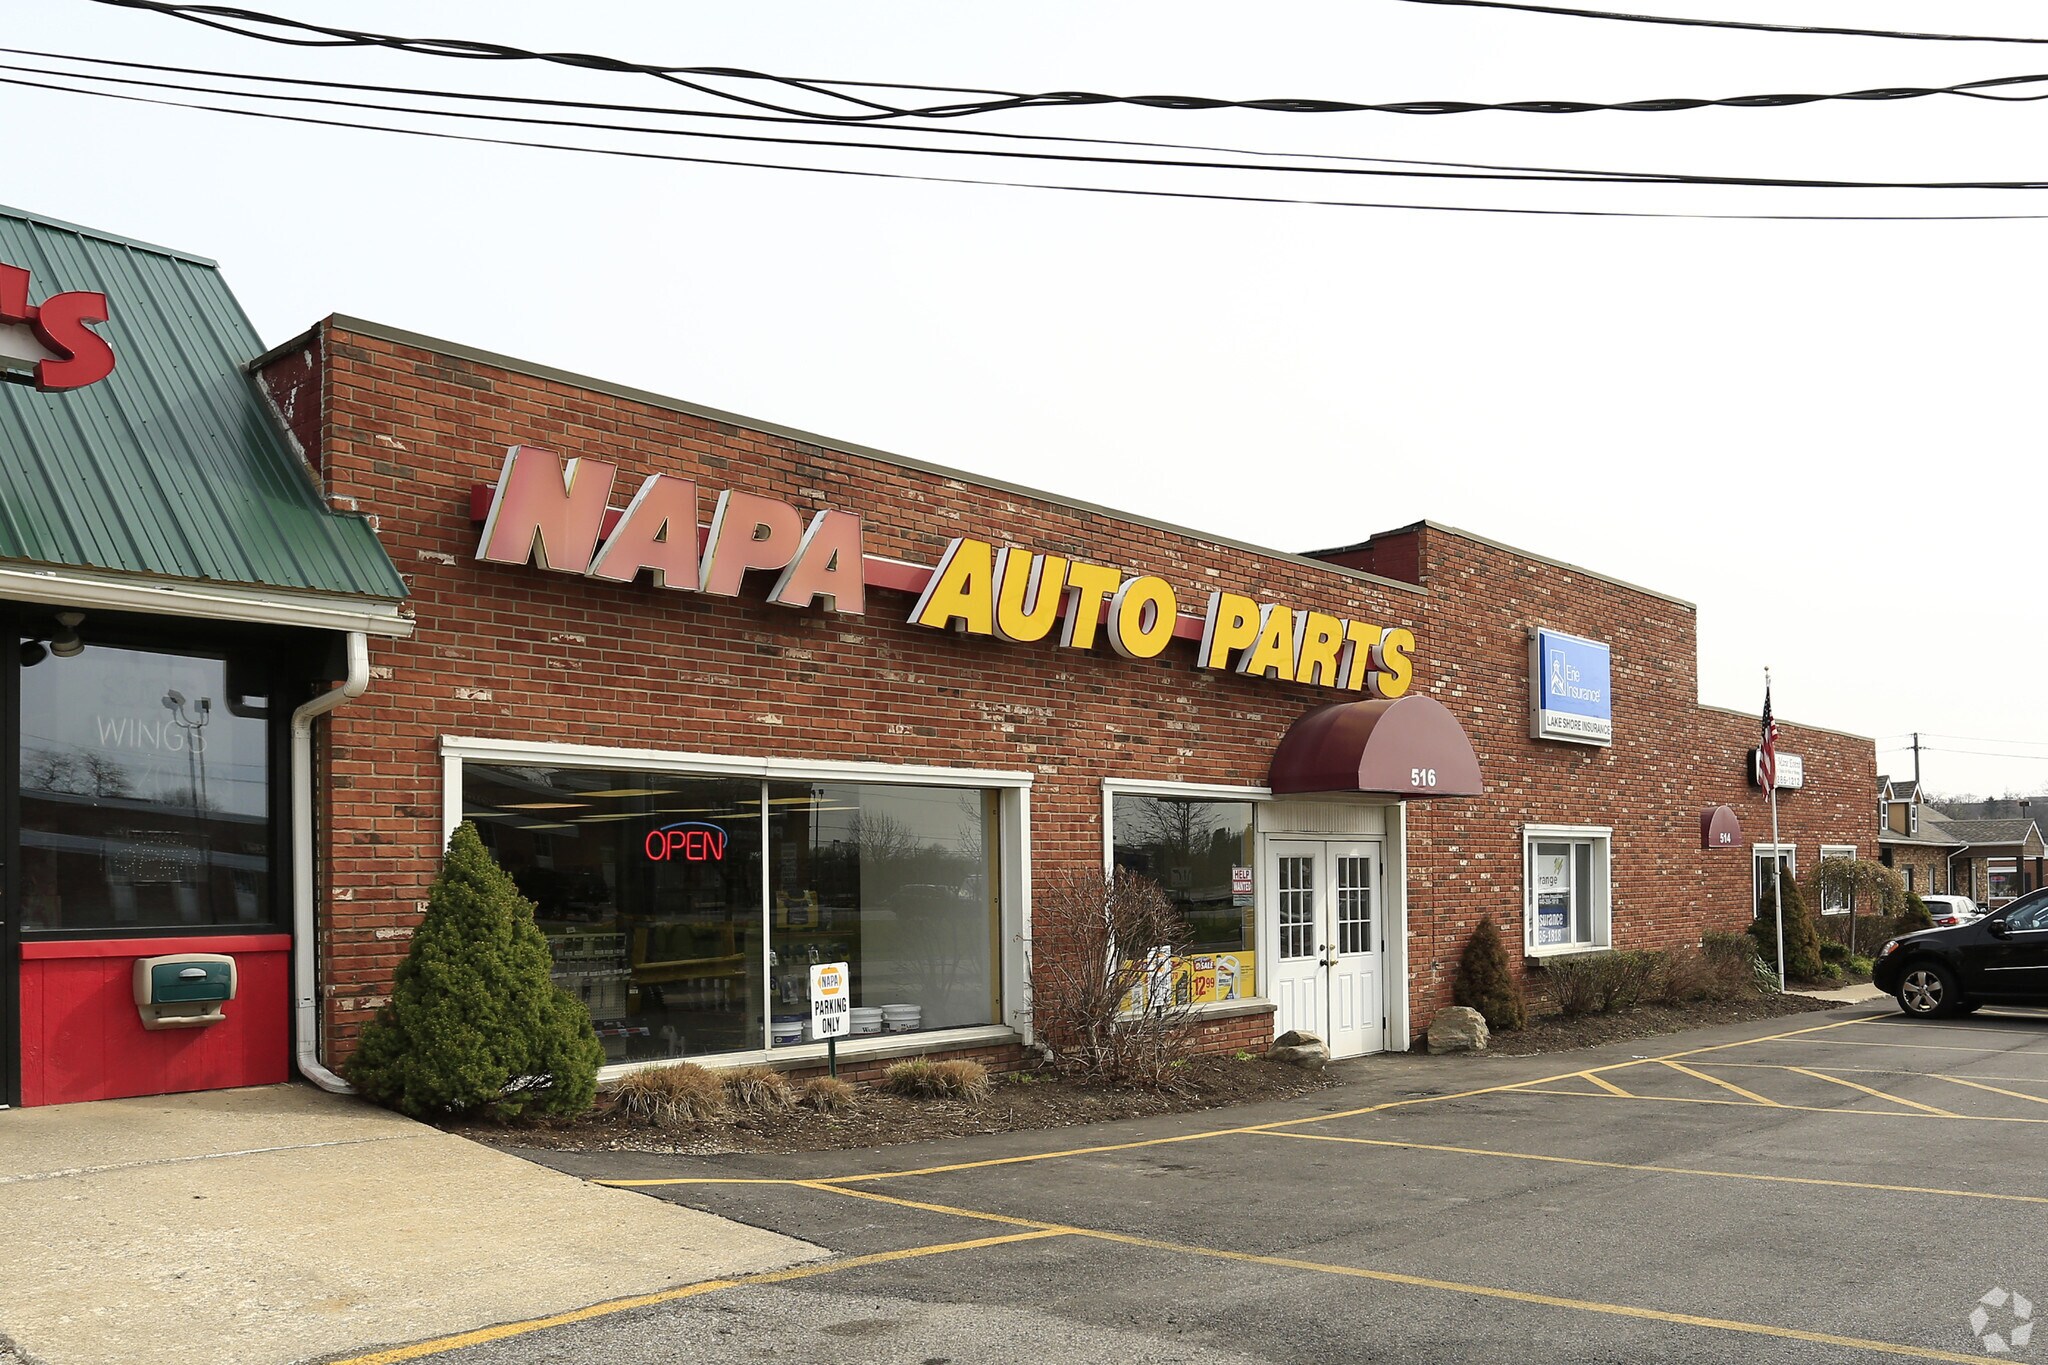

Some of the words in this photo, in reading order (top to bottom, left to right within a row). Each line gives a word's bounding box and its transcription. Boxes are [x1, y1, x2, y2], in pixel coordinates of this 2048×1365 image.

[475, 444, 866, 616] NAPA
[906, 537, 1178, 659] AUTO
[1197, 591, 1416, 699] PARTS
[1566, 664, 1580, 683] Erie
[1567, 683, 1600, 702] Insurance
[97, 715, 208, 754] WINGS
[1547, 716, 1562, 729] LAKE
[1563, 719, 1581, 731] SHORE
[1582, 721, 1611, 736] INSURANCE
[1411, 768, 1437, 787] 516
[645, 830, 723, 861] OPEN
[1719, 832, 1732, 844] 514
[1234, 870, 1250, 879] HELP
[1539, 875, 1558, 886] range
[1233, 882, 1252, 891] WANTED
[1539, 914, 1563, 926] surance
[1201, 960, 1214, 970] SALE
[821, 974, 838, 988] NAPA
[815, 997, 847, 1017] PARKING
[822, 1016, 840, 1034] ONLY
